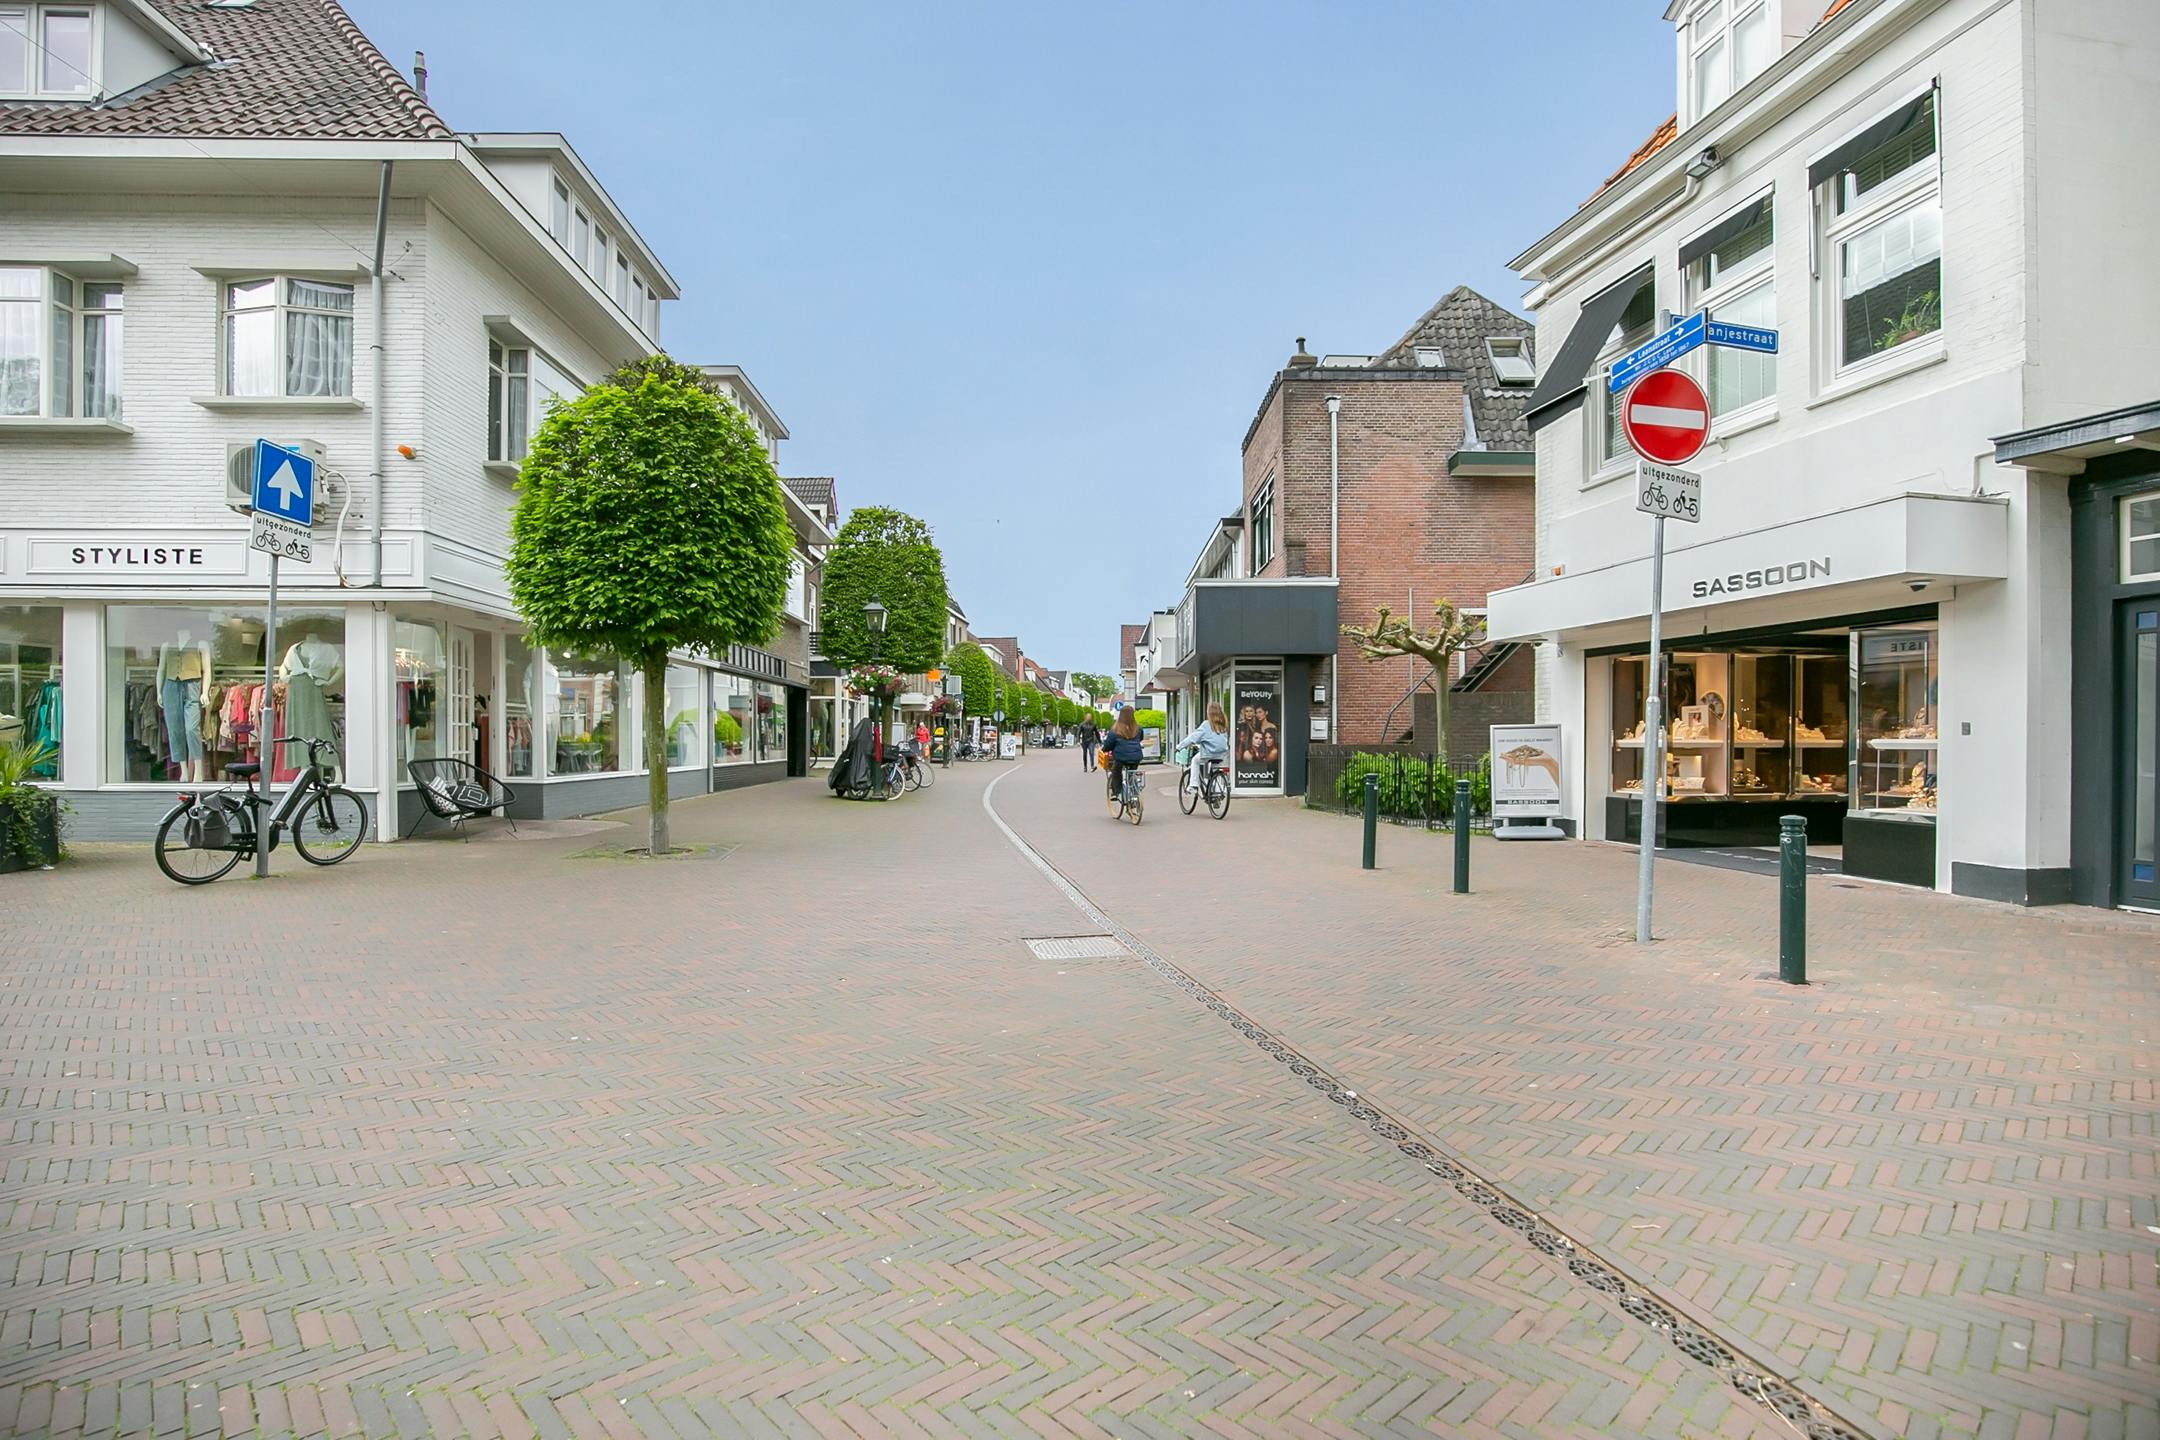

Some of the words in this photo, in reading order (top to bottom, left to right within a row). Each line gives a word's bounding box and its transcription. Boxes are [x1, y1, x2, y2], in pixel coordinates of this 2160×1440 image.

[1637, 336, 1671, 360] Laanstraat
[1642, 466, 1700, 488] uitgezonderd
[256, 517, 312, 539] uitgezonderd
[71, 547, 203, 565] STYLISTE
[1692, 556, 1831, 599] SASSOON
[1240, 690, 1273, 699] BeYOUty
[1237, 770, 1274, 779] hannah
